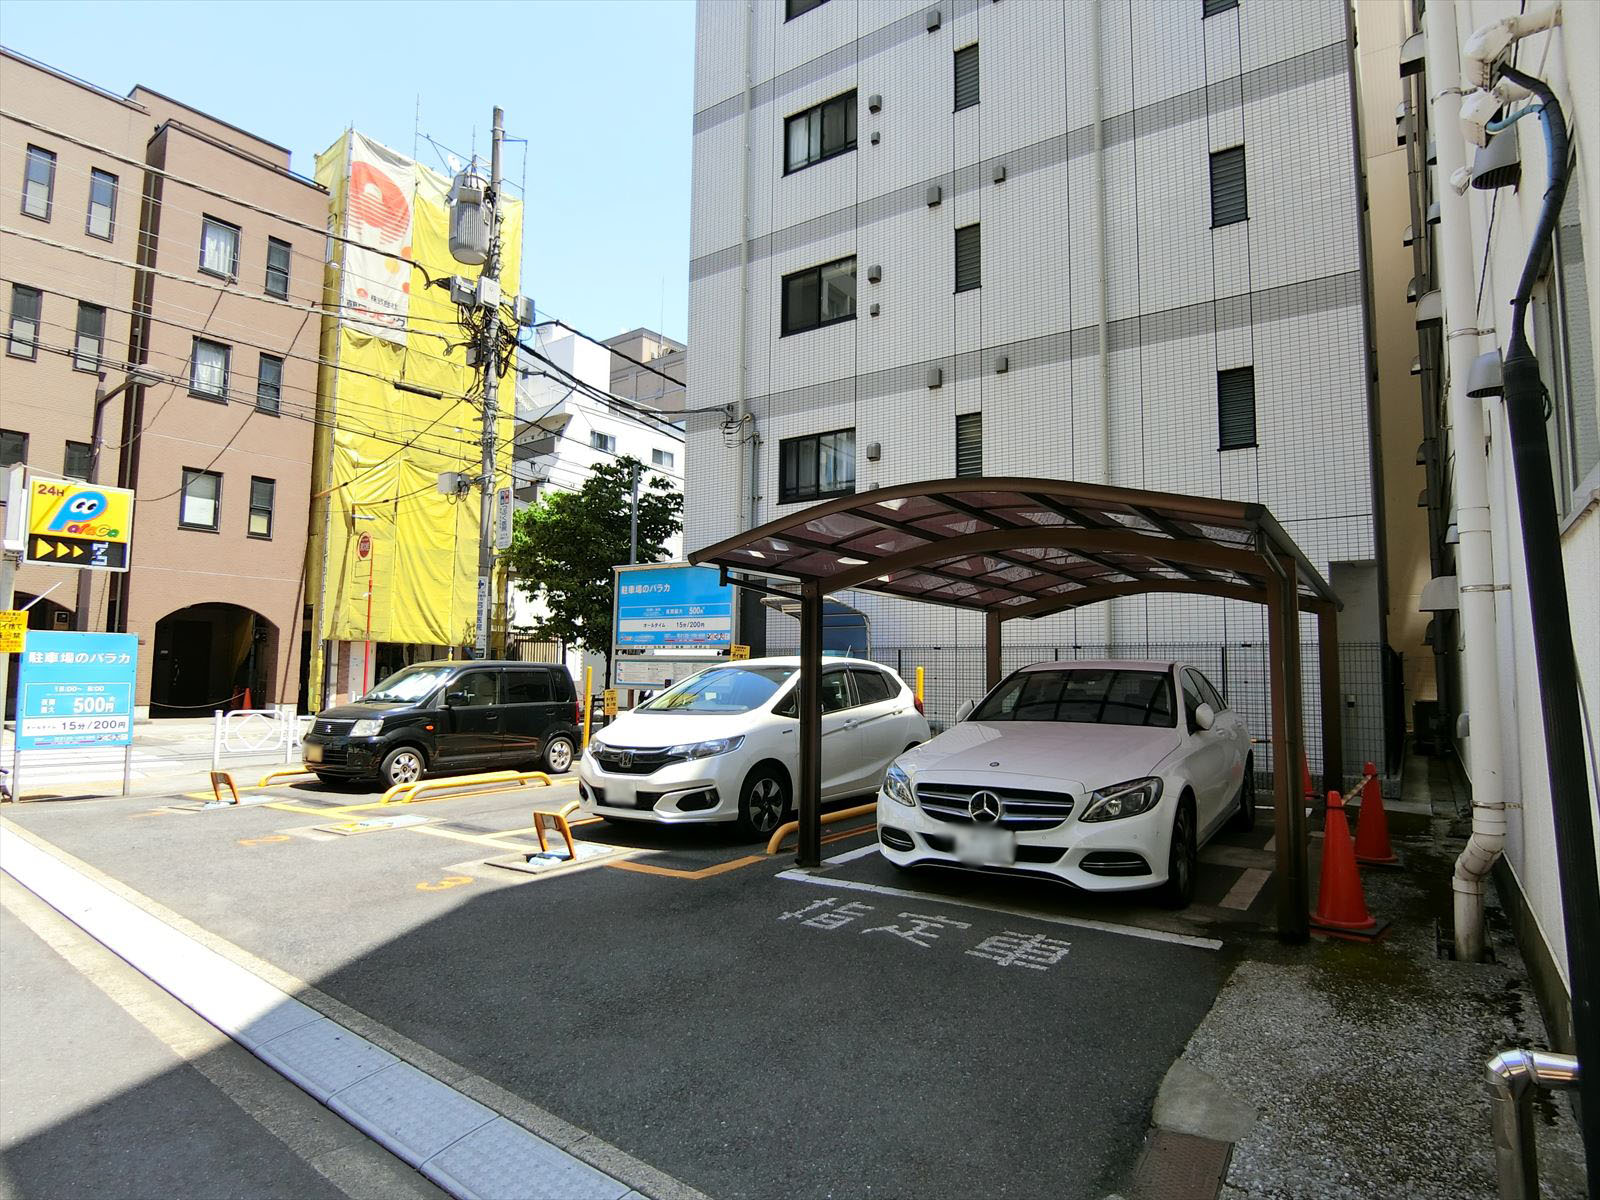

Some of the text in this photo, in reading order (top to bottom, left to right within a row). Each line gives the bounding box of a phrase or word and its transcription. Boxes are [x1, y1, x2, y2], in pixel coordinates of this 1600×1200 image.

[38, 484, 64, 497] 24H
[73, 697, 115, 714] 500円
[61, 720, 127, 731] 15分/200円
